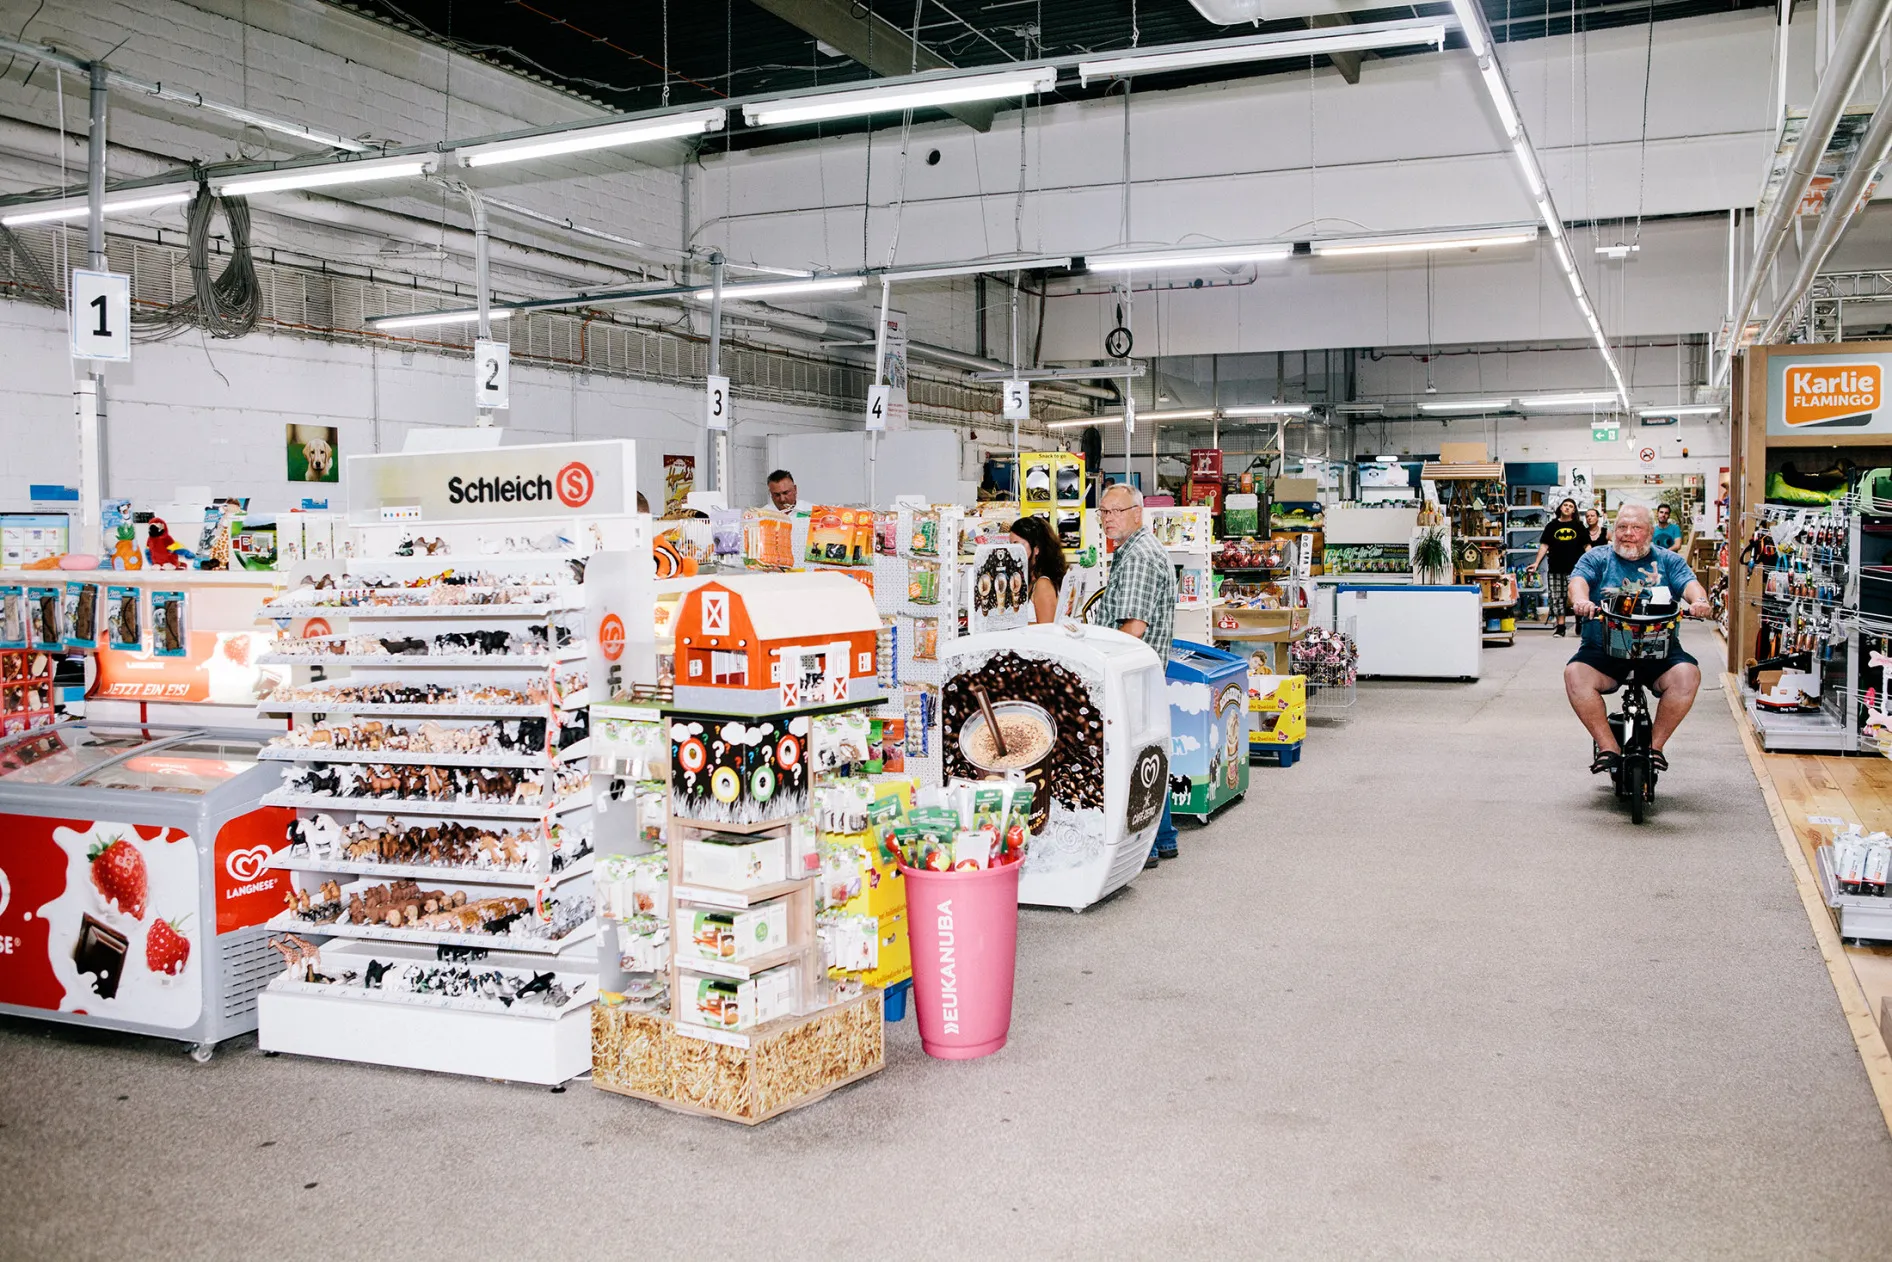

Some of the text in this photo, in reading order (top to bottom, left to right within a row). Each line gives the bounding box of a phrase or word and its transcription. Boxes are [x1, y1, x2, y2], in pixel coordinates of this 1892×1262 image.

[90, 295, 112, 337] 1
[485, 358, 499, 391] 2
[1793, 371, 1874, 395] Karlie
[713, 389, 721, 416] 3
[872, 396, 882, 418] 4
[1011, 390, 1022, 409] 5
[1793, 394, 1874, 408] FLAMINGO
[448, 475, 552, 504] Schleich
[103, 682, 190, 696] JETZT EIN EIS!
[937, 898, 959, 1022] EUKANUBA
